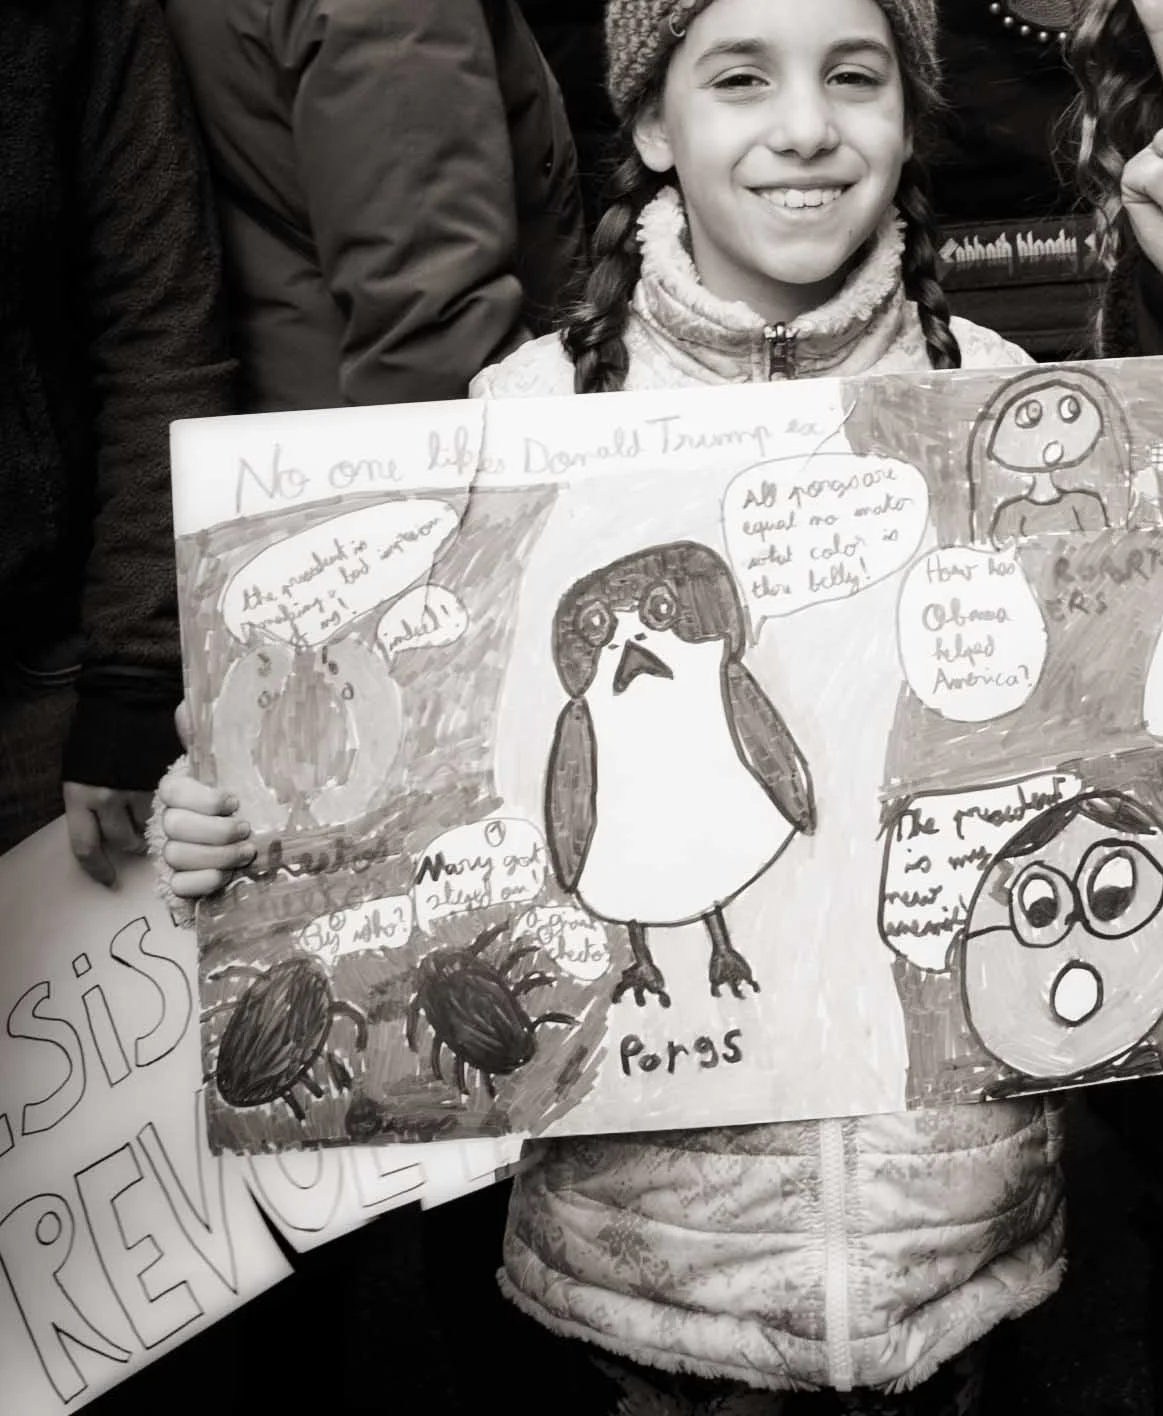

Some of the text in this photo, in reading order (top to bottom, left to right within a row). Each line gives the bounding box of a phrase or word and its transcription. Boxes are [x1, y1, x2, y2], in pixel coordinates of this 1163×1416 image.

[235, 442, 310, 514] No
[327, 456, 403, 492] one
[522, 428, 643, 477] Donald
[644, 415, 772, 457] Trump
[742, 510, 799, 543] equal
[808, 514, 840, 528] no
[809, 533, 867, 561] color
[881, 529, 899, 543] is
[926, 554, 1018, 585] How has
[921, 596, 1013, 632] Obama
[934, 633, 996, 668] helped
[932, 664, 1034, 695] America?
[416, 841, 546, 886] Mary got
[619, 1028, 743, 1077] Porgs
